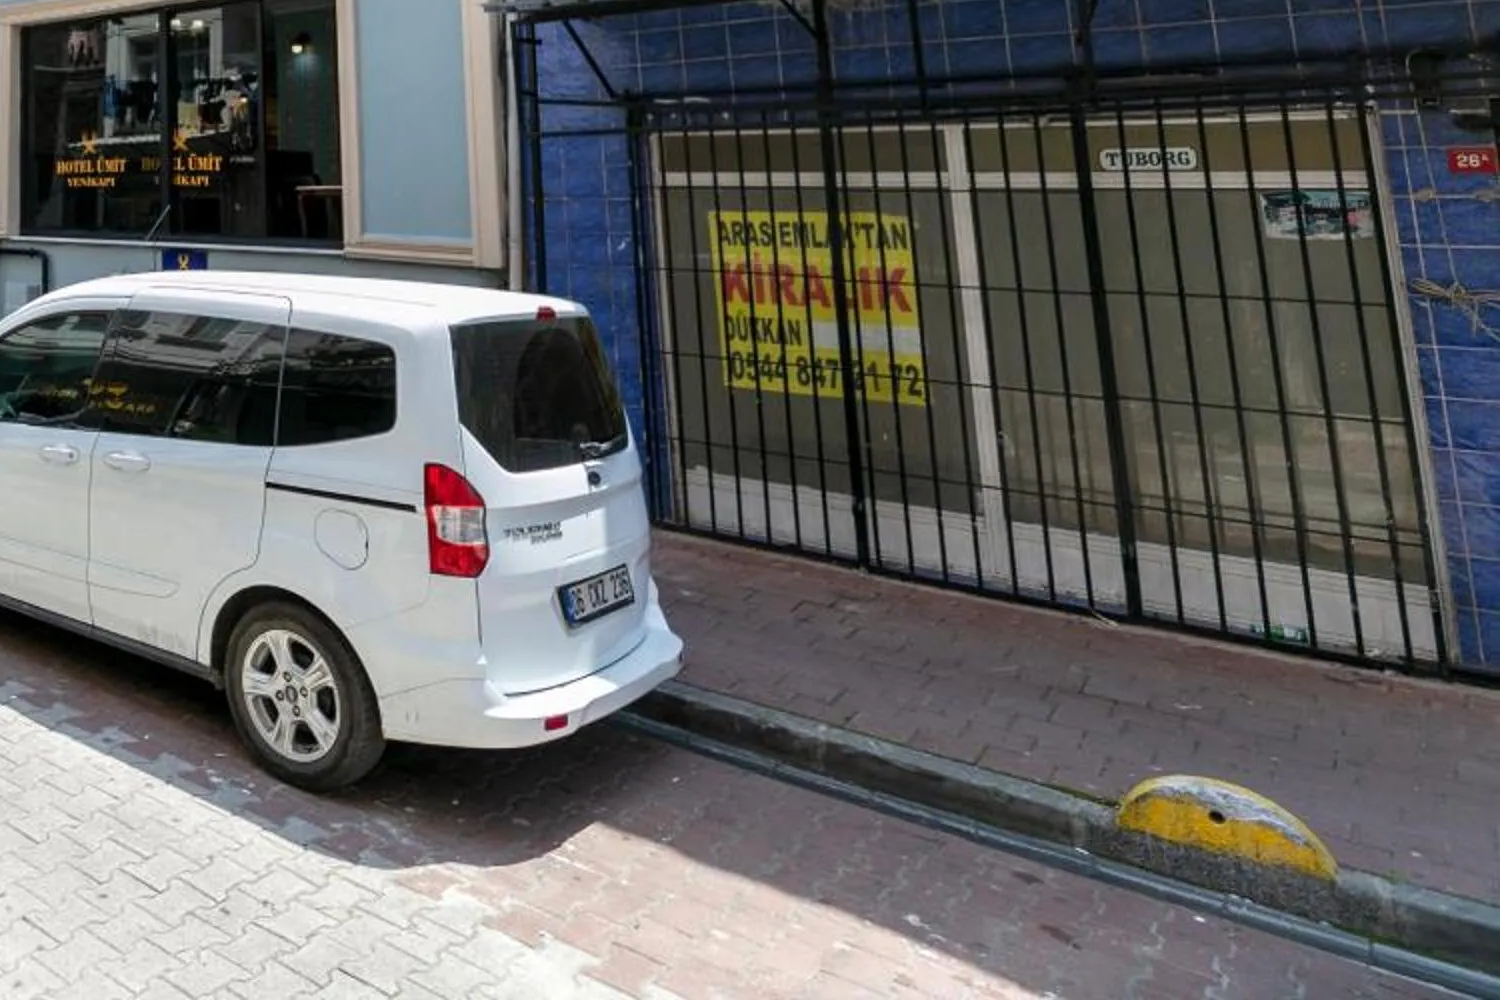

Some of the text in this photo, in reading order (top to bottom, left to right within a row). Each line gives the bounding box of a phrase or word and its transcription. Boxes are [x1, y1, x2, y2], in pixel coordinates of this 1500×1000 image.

[57, 158, 95, 175] HOTEL
[1105, 151, 1191, 167] TUBORG
[718, 220, 772, 247] ARAS
[723, 250, 912, 313] KİRAIK
